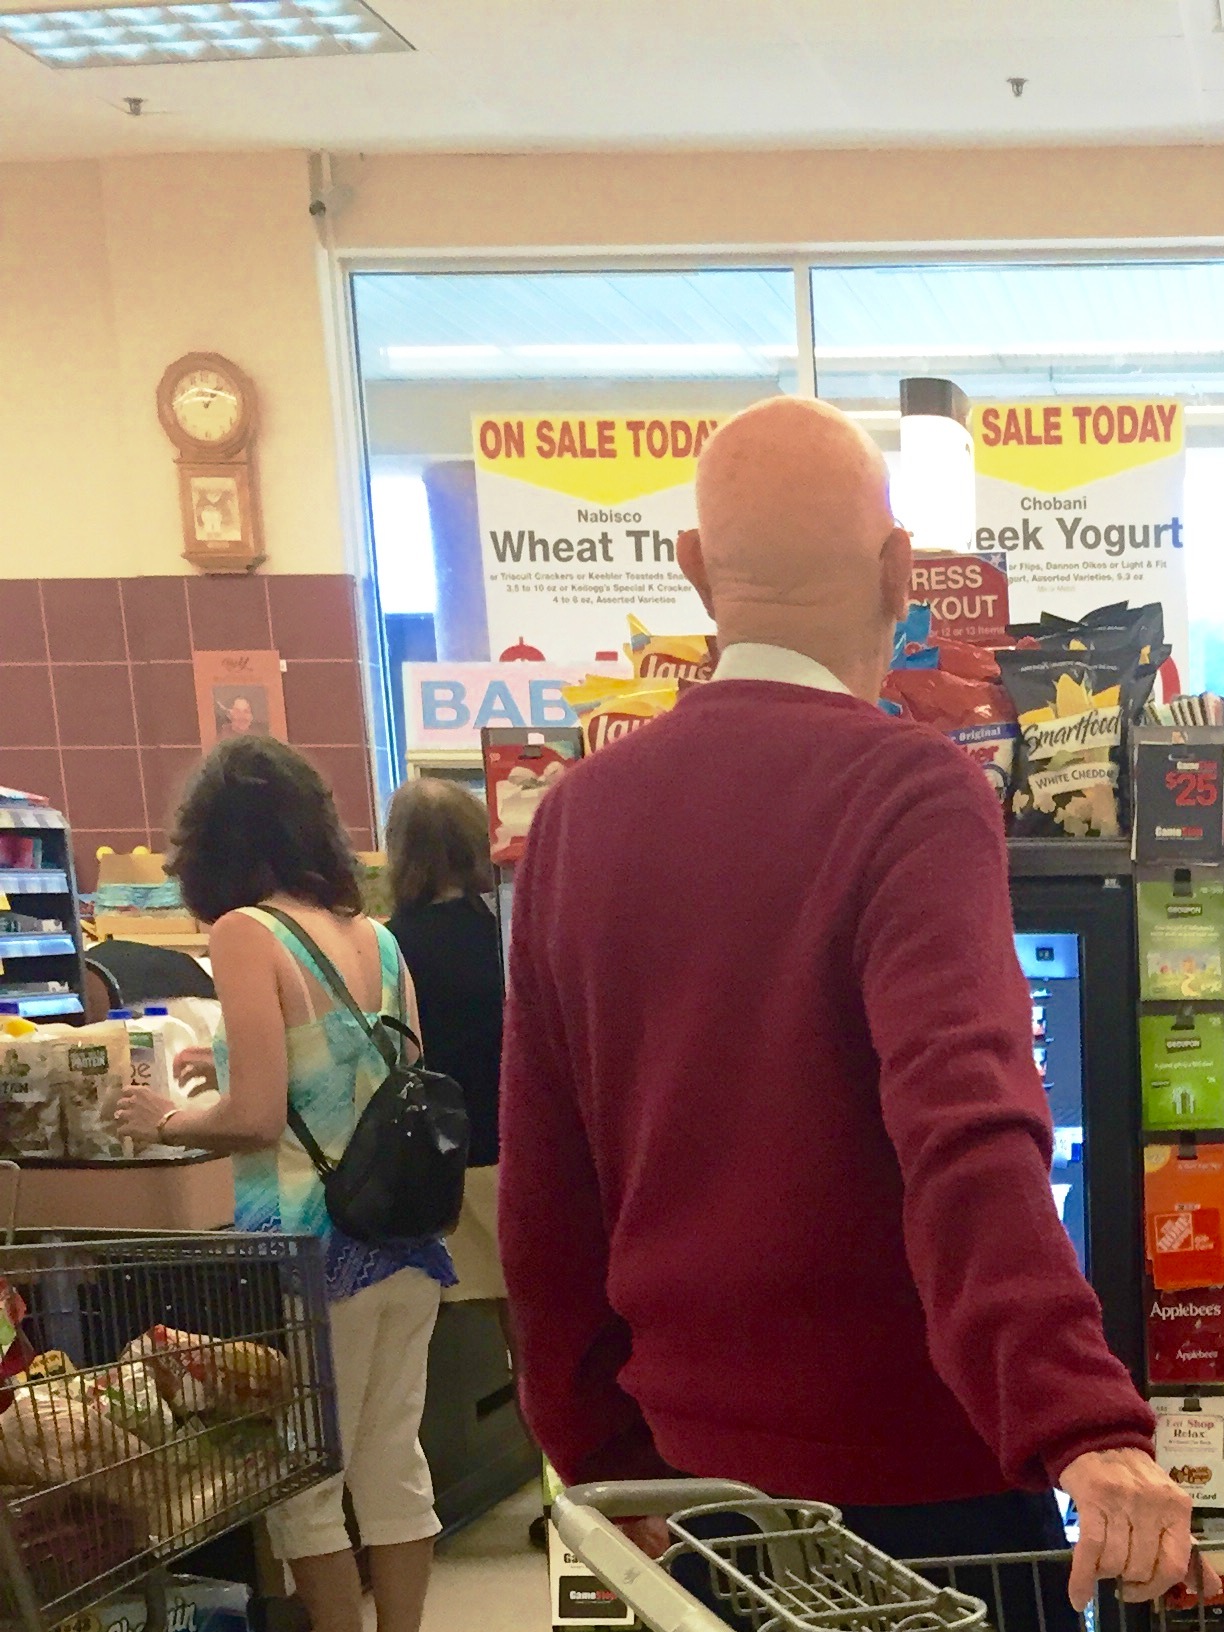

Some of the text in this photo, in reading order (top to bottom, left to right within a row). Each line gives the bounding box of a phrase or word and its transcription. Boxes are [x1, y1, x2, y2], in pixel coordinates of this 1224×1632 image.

[981, 404, 1178, 447] SALE TODAY
[479, 420, 718, 459] ON SALE TODA
[1020, 495, 1088, 511] Chobani
[577, 509, 642, 523] Nabisco
[975, 516, 1184, 557] eek Yogurt
[489, 530, 684, 563] Wheat Th
[1046, 561, 1080, 571] Dannon
[1082, 560, 1107, 570] Oikos
[1121, 560, 1144, 571] Light
[500, 572, 532, 581] Triscuit
[534, 572, 574, 581] Crackers
[576, 573, 586, 581] or
[588, 572, 623, 580] Keebler
[1031, 574, 1071, 583] Assorted
[612, 583, 645, 593] Special
[596, 595, 635, 604] Assorted
[637, 595, 676, 604] Varieties
[958, 726, 1001, 741] Original
[1022, 709, 1123, 756] Smartfood
[1034, 772, 1071, 790] WHITE
[1165, 771, 1218, 806] $25
[1149, 1299, 1222, 1321] Applebee's
[1187, 1419, 1215, 1430] Shop
[1173, 1428, 1206, 1438] Relax
